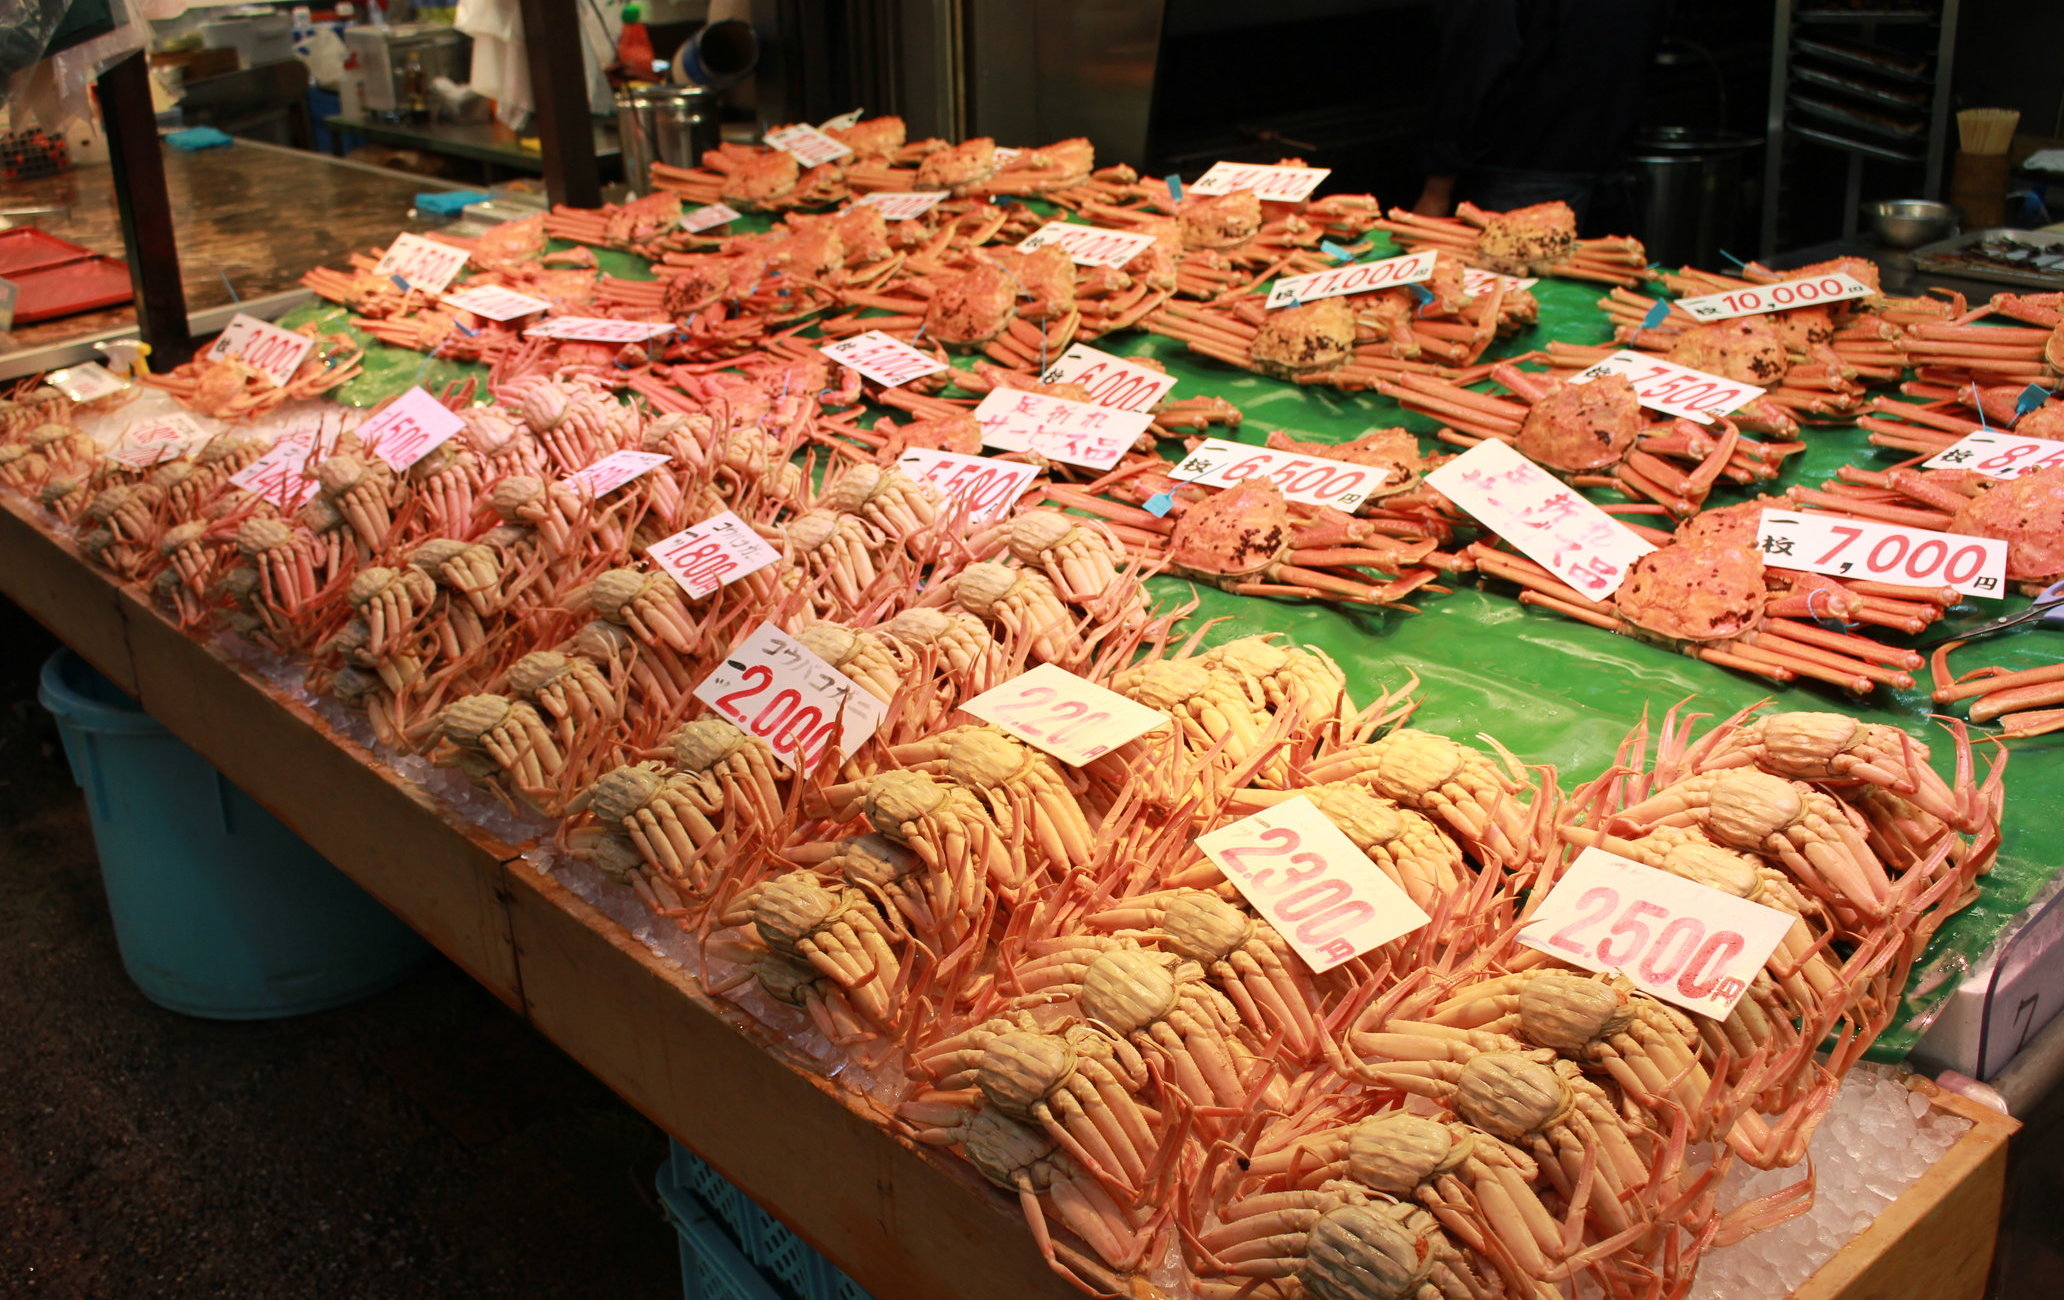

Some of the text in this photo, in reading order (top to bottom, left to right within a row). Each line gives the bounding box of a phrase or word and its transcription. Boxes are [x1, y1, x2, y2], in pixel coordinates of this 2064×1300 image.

[1722, 279, 1864, 313] 10,000円
[981, 414, 1122, 461] サービス品
[1762, 519, 1801, 557] 一枚
[1813, 525, 1999, 591] 7,000円
[762, 638, 872, 720] コウバコガニ
[1548, 887, 1746, 1006] 2.500円
